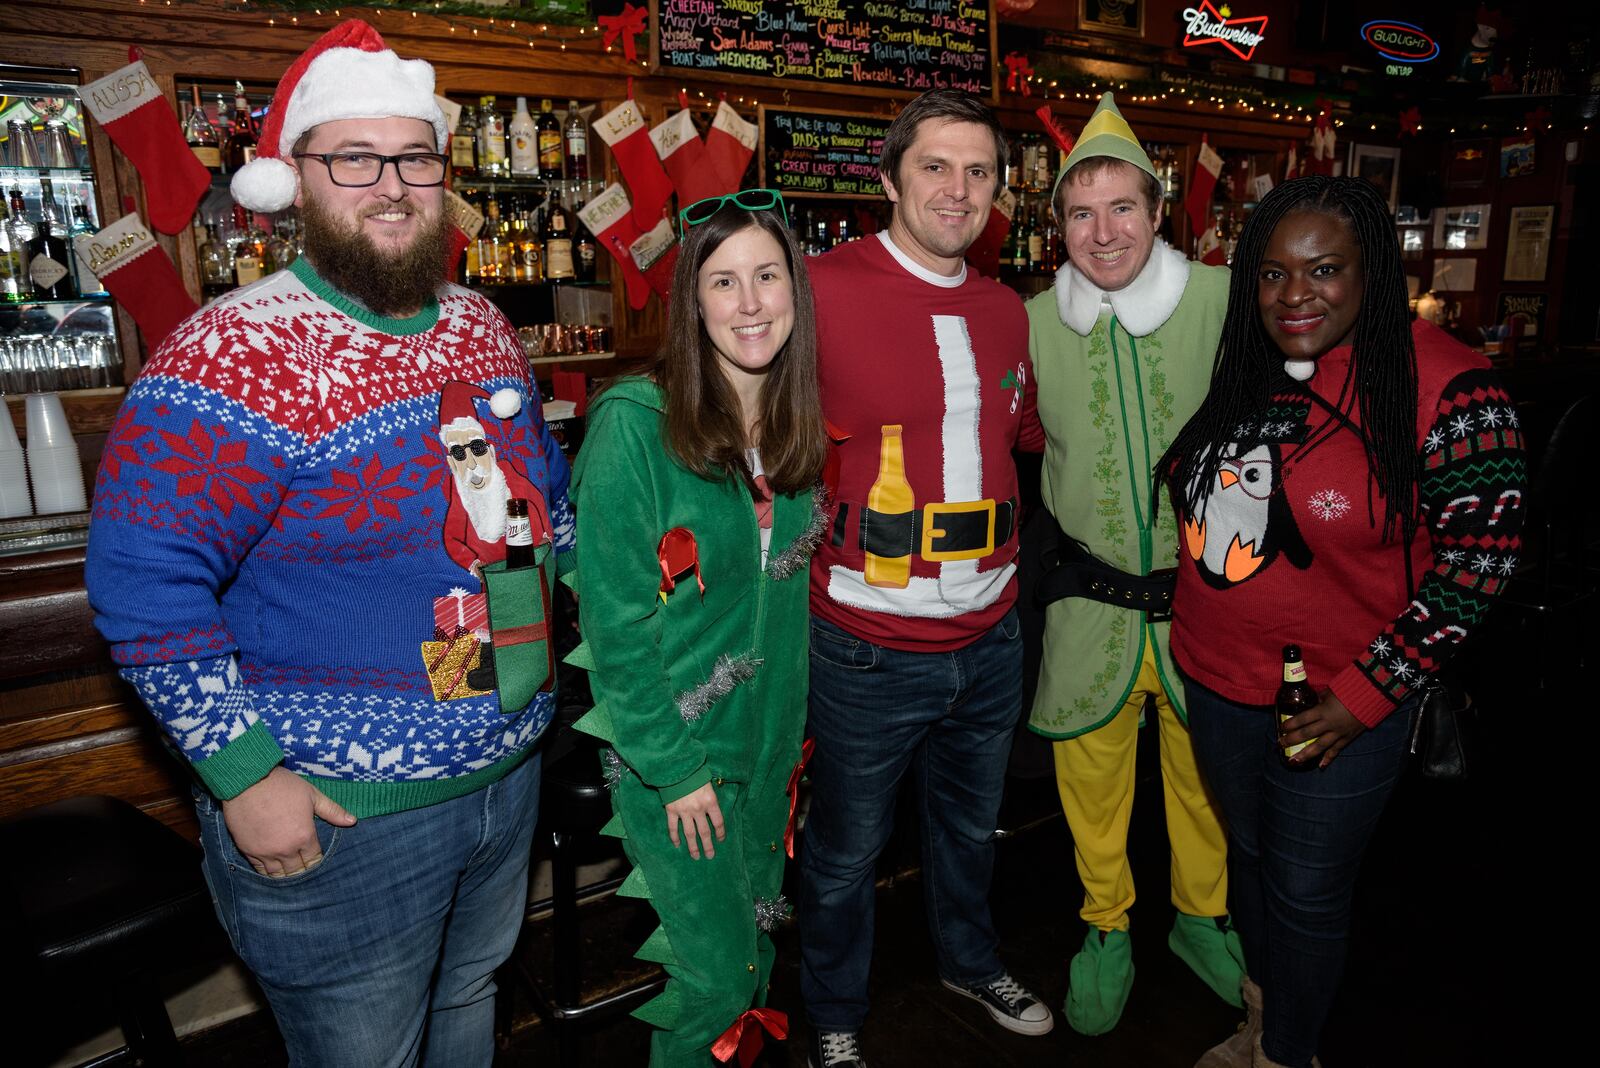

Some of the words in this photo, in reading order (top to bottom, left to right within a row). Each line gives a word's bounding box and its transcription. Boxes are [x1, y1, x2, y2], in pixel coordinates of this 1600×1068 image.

[670, 0, 714, 14] CHEETAH
[723, 0, 764, 14] STARDUST
[959, 2, 986, 20] Corona
[664, 7, 698, 35] Angry
[698, 11, 740, 30] Orchard
[754, 11, 784, 32] Blue
[786, 10, 808, 32] Moon
[817, 17, 845, 39] Coors
[846, 21, 871, 40] Light
[1183, 8, 1264, 47] Budweiser
[710, 26, 738, 51] Sam
[740, 30, 775, 51] Adams
[880, 25, 912, 43] Sierra
[913, 28, 943, 47] Nevada
[943, 32, 976, 53] Torpedo
[1374, 29, 1397, 45] BUD
[1398, 34, 1427, 49] LIGHT
[672, 51, 695, 66] BOAT
[720, 51, 769, 71] HEINEKEN
[872, 42, 907, 65] Rolling
[907, 44, 934, 65] Rock
[773, 55, 815, 77] Banana
[815, 57, 845, 79] Bread
[853, 61, 898, 84] Newcastle
[1386, 65, 1399, 76] ON
[91, 70, 155, 113] ALYSSA
[795, 117, 812, 131] ONE
[814, 119, 825, 132] OF
[782, 160, 810, 174] GREAT
[812, 162, 838, 177] LAKES
[783, 175, 801, 187] SAM
[803, 176, 828, 191] ADAMS
[1504, 295, 1544, 307] SAMUEL
